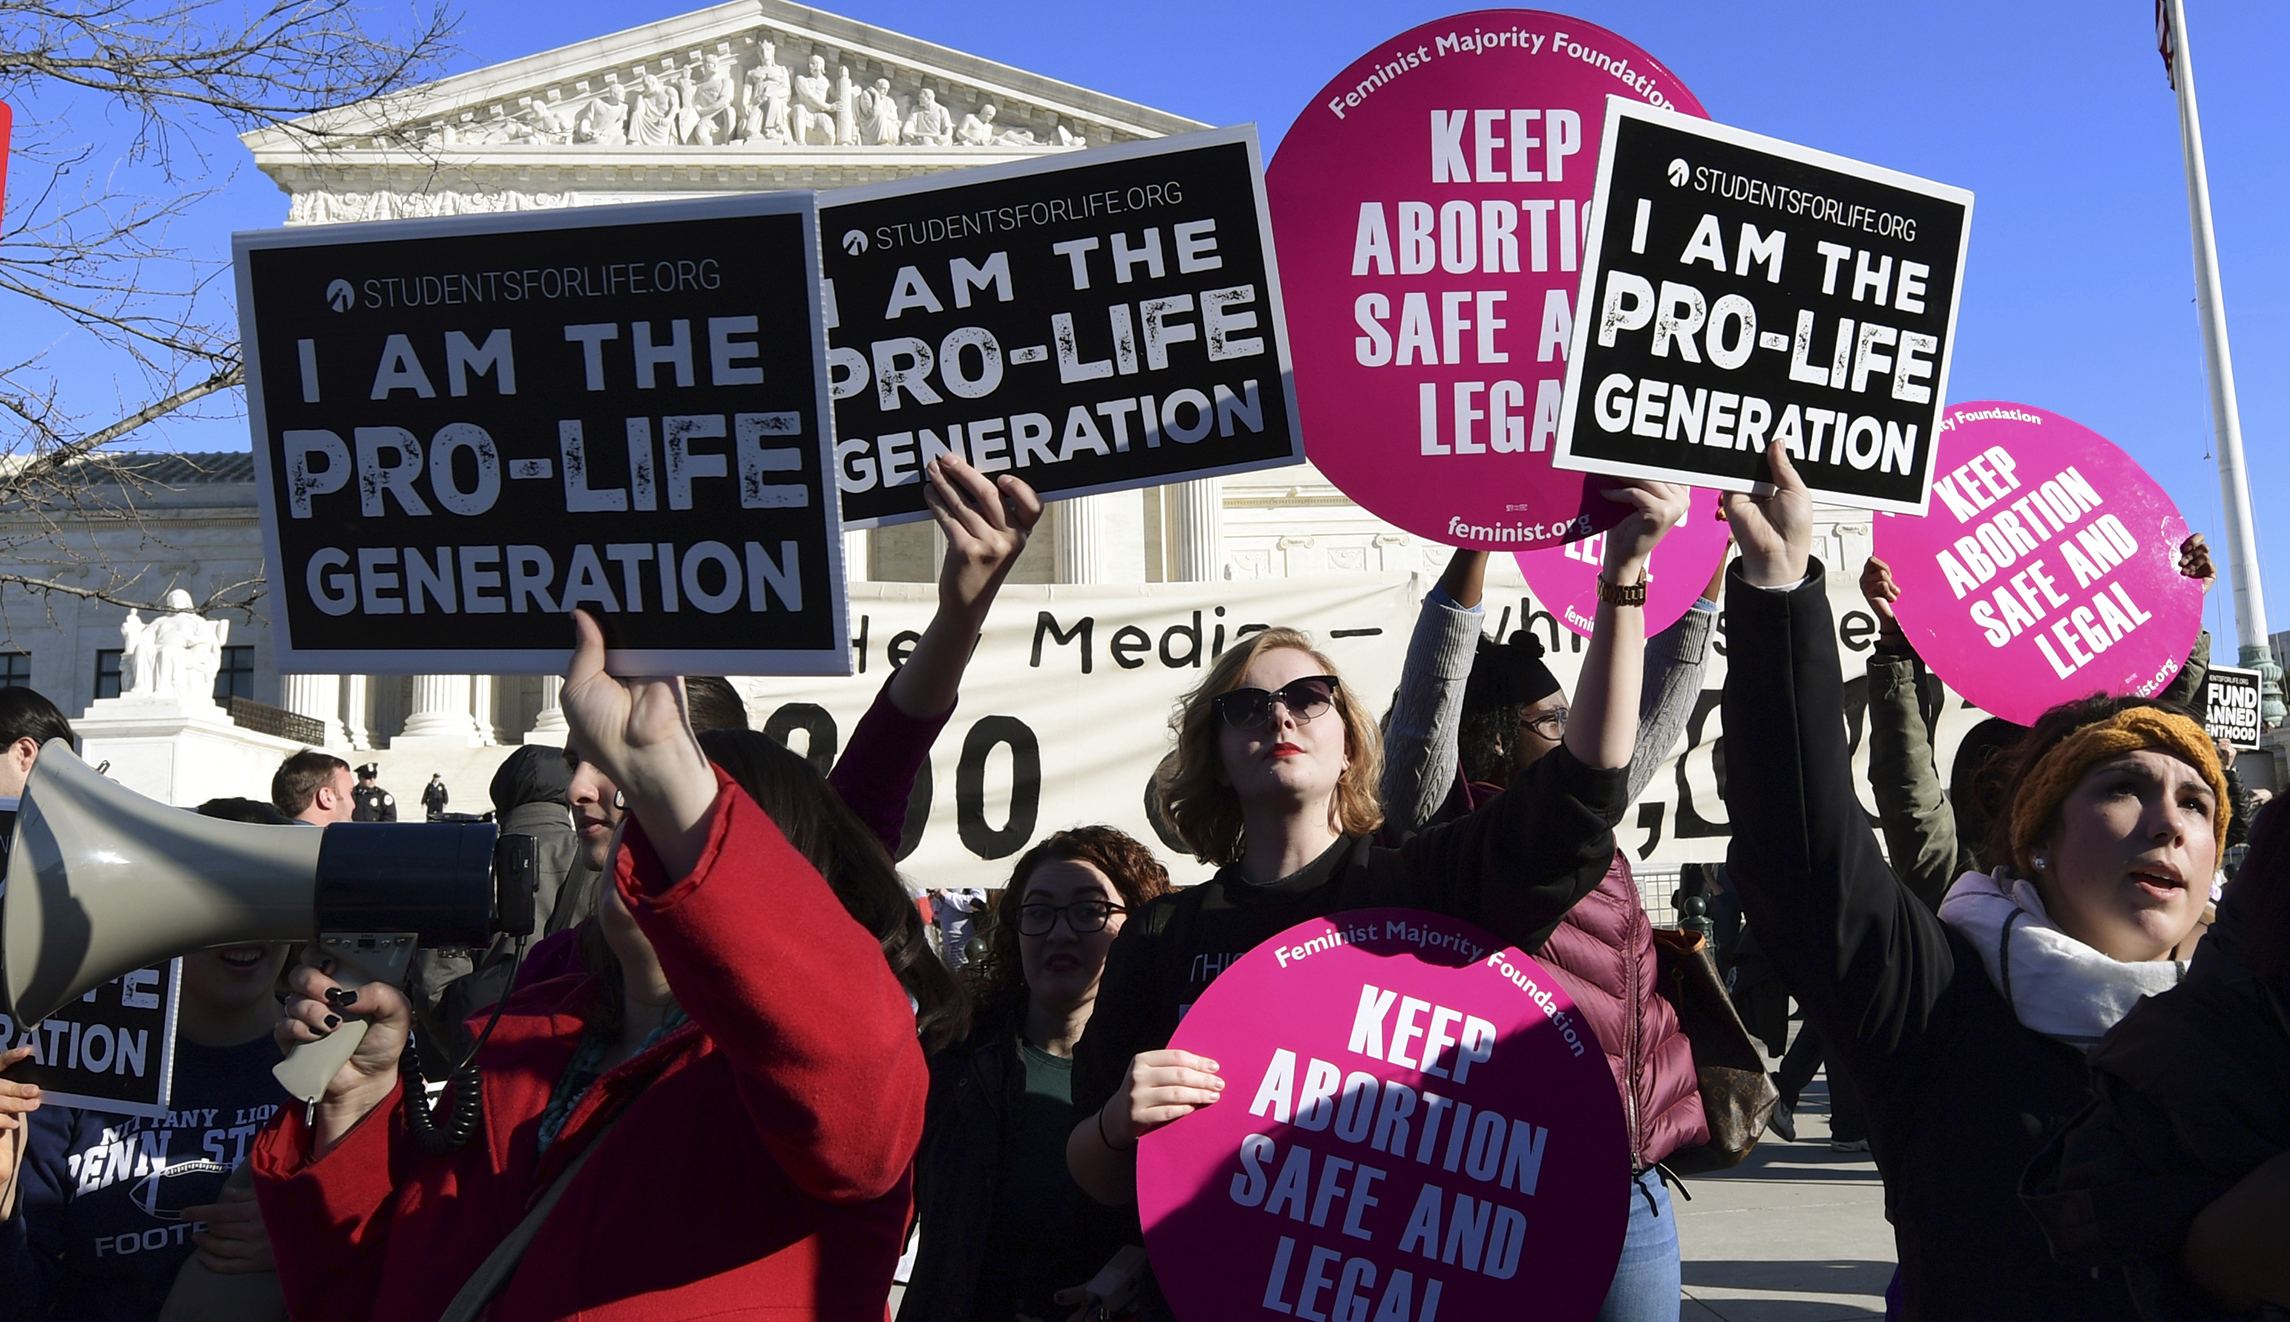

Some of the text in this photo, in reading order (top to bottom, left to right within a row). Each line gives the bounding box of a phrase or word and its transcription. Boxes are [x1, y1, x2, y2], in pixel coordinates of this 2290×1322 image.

[1328, 44, 1431, 120] Feminist
[1435, 26, 1545, 58] Majority
[1430, 108, 1582, 184] KEEP
[875, 180, 1184, 250] STUDENTSFORLIFE.ORG
[1351, 199, 1594, 276] ABORTI
[1693, 165, 1918, 242] STUDENTSFORLIFE.ORG
[363, 258, 721, 310] STUDENTSFORLIFE.ORG
[885, 251, 1014, 320] AM
[1053, 218, 1223, 290] THE
[1631, 198, 1931, 314] I AM THE
[297, 315, 765, 404] I AM THE
[828, 284, 1265, 412] PRO-LIFE
[1354, 290, 1509, 367] SAFE
[1597, 269, 1939, 405] PRO-LIFE
[836, 379, 1265, 494] GENERATION
[1594, 372, 1918, 476] GENERATION
[1955, 407, 2042, 425] Foundation
[282, 410, 810, 520] PRO-LIFE
[1932, 445, 2022, 524] KEEP
[1447, 513, 1593, 544] feminist.org
[1935, 465, 2104, 600] ABORTION
[305, 540, 803, 617] GENERATION
[1969, 558, 2070, 648] SAFE
[2058, 513, 2139, 590] AND
[1029, 606, 1270, 675] Medi
[2034, 580, 2153, 681] LEGAL
[2134, 657, 2179, 699] ist.org
[1274, 920, 1586, 1059] Feminist Majority Foundation
[1347, 983, 1498, 1086] KEEP
[1247, 1047, 1549, 1198] ABORTION
[1229, 1133, 1528, 1280] SAFE AND
